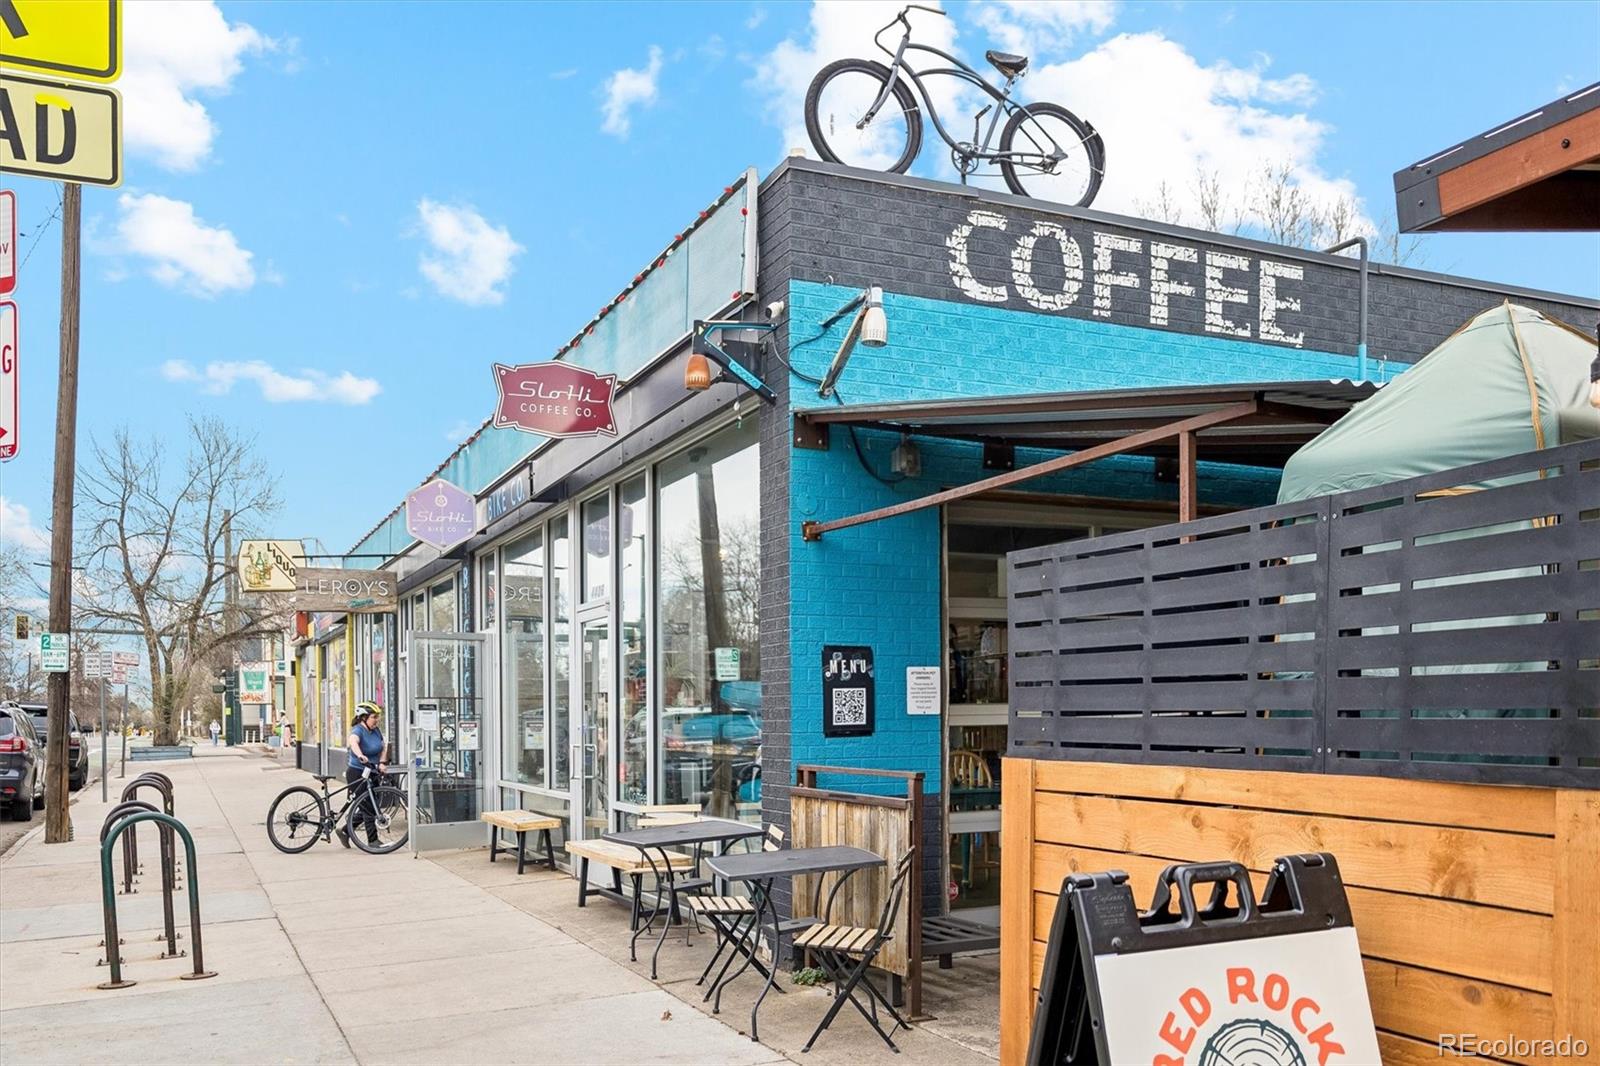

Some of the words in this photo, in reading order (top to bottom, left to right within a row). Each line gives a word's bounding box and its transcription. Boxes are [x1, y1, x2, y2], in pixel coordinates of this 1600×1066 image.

[945, 210, 1304, 348] COFFEE
[508, 381, 604, 404] SloHi
[520, 402, 569, 416] COFFEE
[575, 407, 597, 419] CO.
[486, 486, 507, 521] BIKE
[510, 476, 525, 506] CO.
[413, 510, 473, 523] SloHi
[266, 542, 296, 578] LIQUO
[305, 578, 390, 597] LEROY'S
[42, 636, 50, 648] 2
[829, 659, 867, 674] MENU
[1226, 967, 1345, 1066] ROCK
